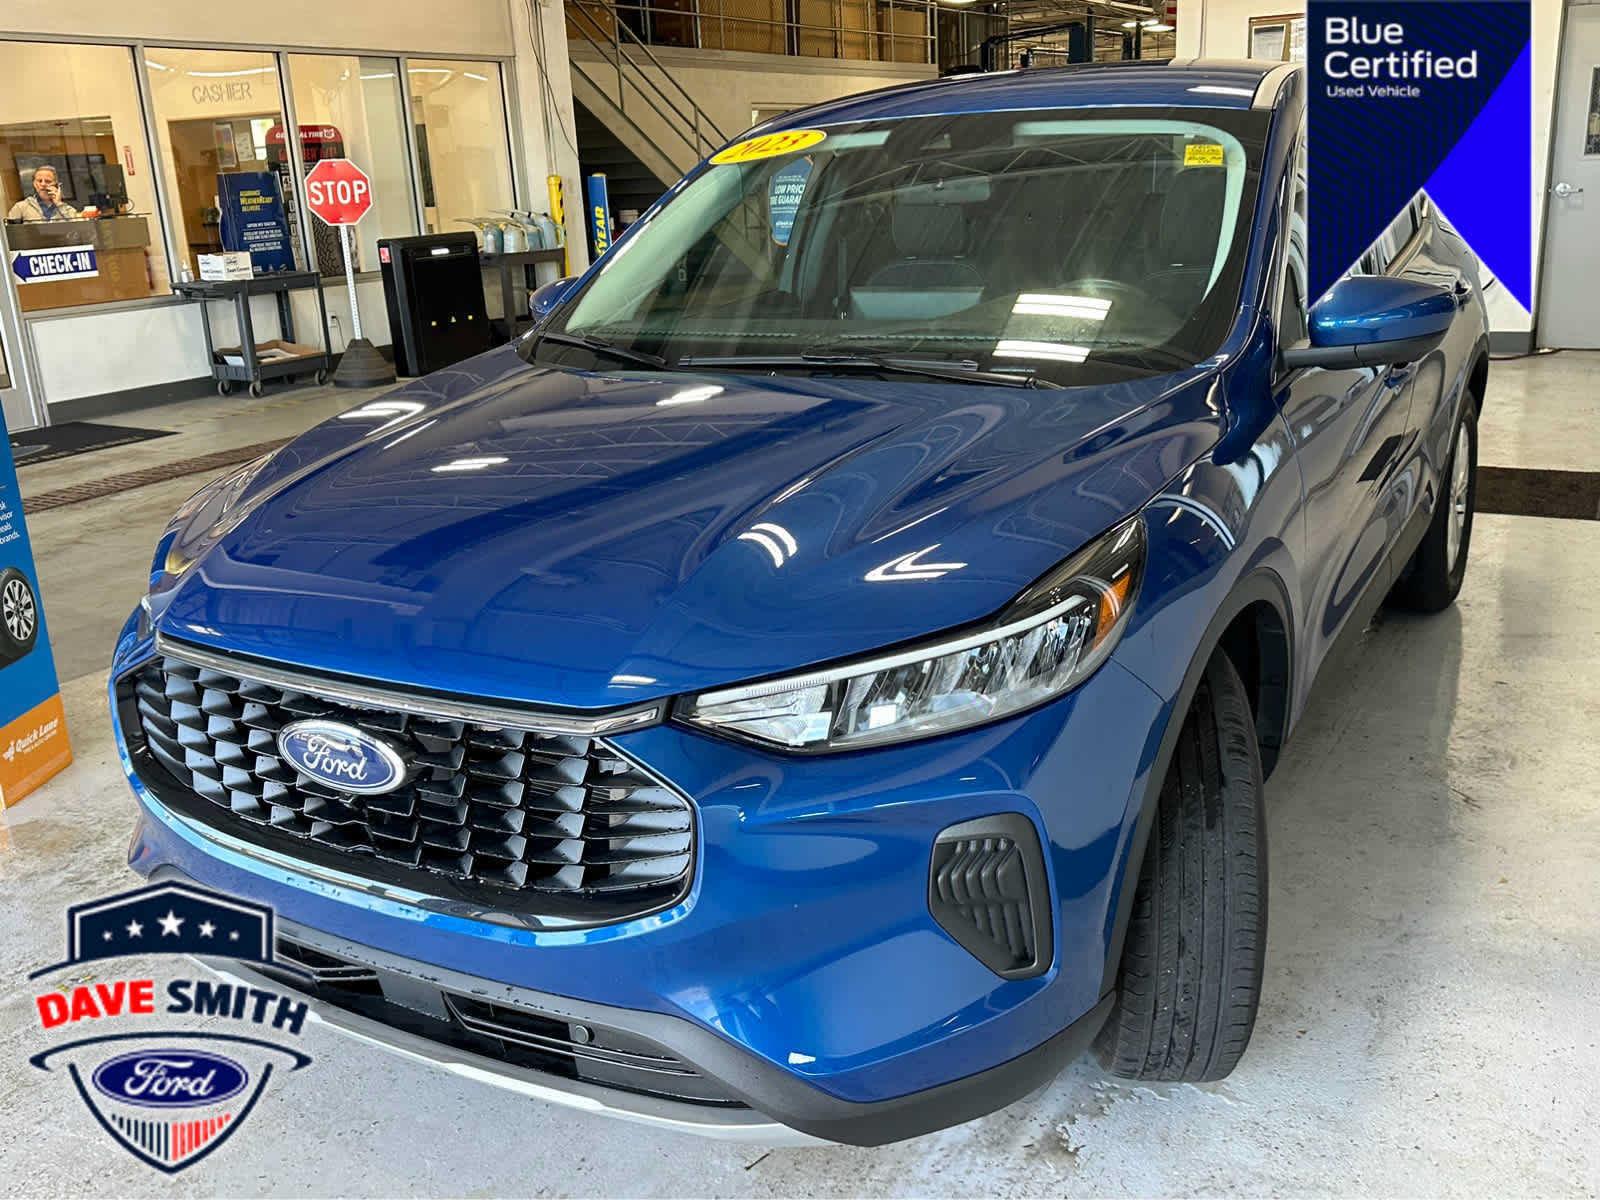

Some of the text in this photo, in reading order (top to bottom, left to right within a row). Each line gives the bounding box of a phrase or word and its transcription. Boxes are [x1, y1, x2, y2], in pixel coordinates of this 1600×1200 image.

[192, 81, 252, 104] CASHIER
[310, 180, 367, 205] STOP
[787, 184, 806, 194] PRIC
[29, 252, 92, 275] CHECK-IN
[303, 735, 368, 780] Ford
